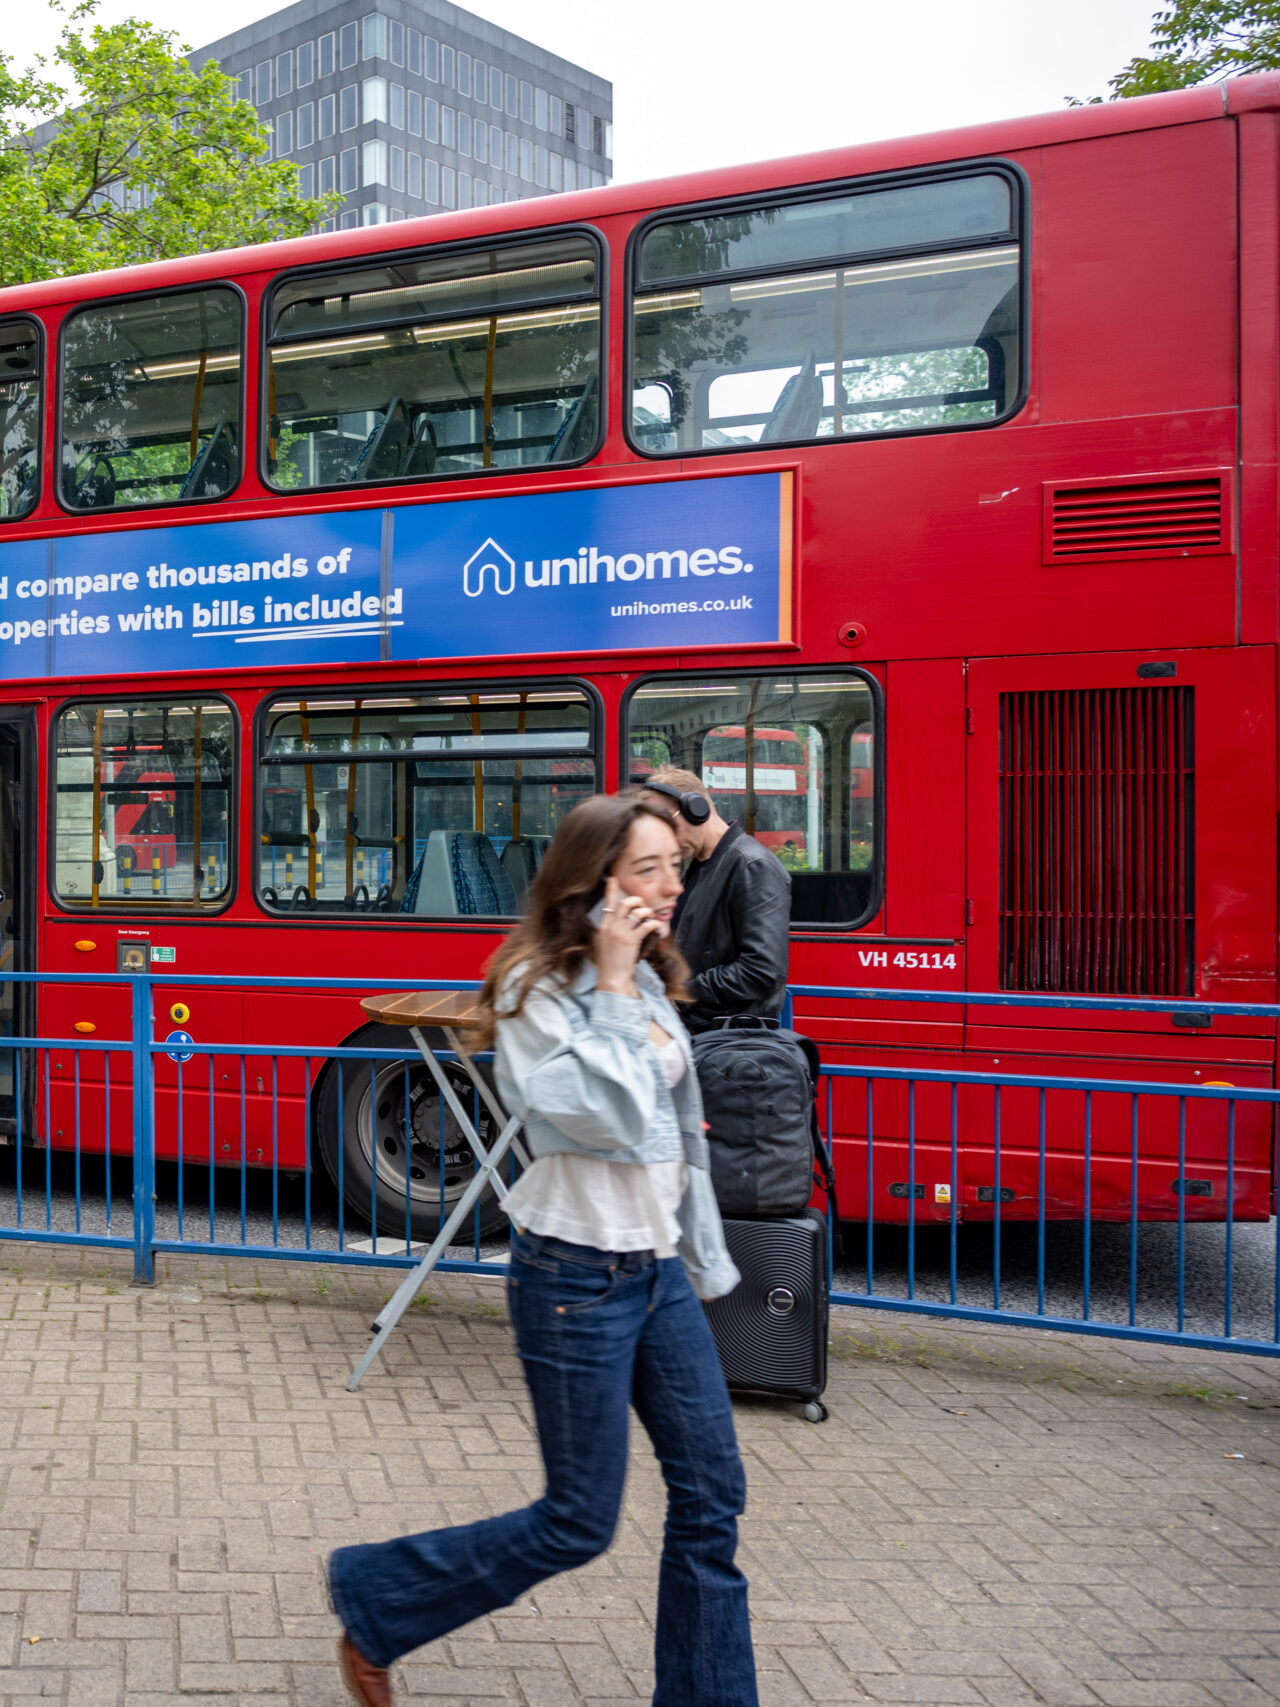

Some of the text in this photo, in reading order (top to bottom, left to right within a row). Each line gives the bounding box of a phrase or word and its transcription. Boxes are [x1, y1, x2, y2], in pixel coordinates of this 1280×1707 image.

[15, 571, 140, 600] compare
[146, 552, 309, 589] thousands
[316, 547, 353, 576] of
[524, 545, 754, 588] unihomes.
[117, 604, 183, 632] with
[192, 599, 256, 628] bills
[264, 588, 403, 622] included
[610, 594, 753, 617] unihomes.co.uk
[858, 951, 957, 969] VH 45114
